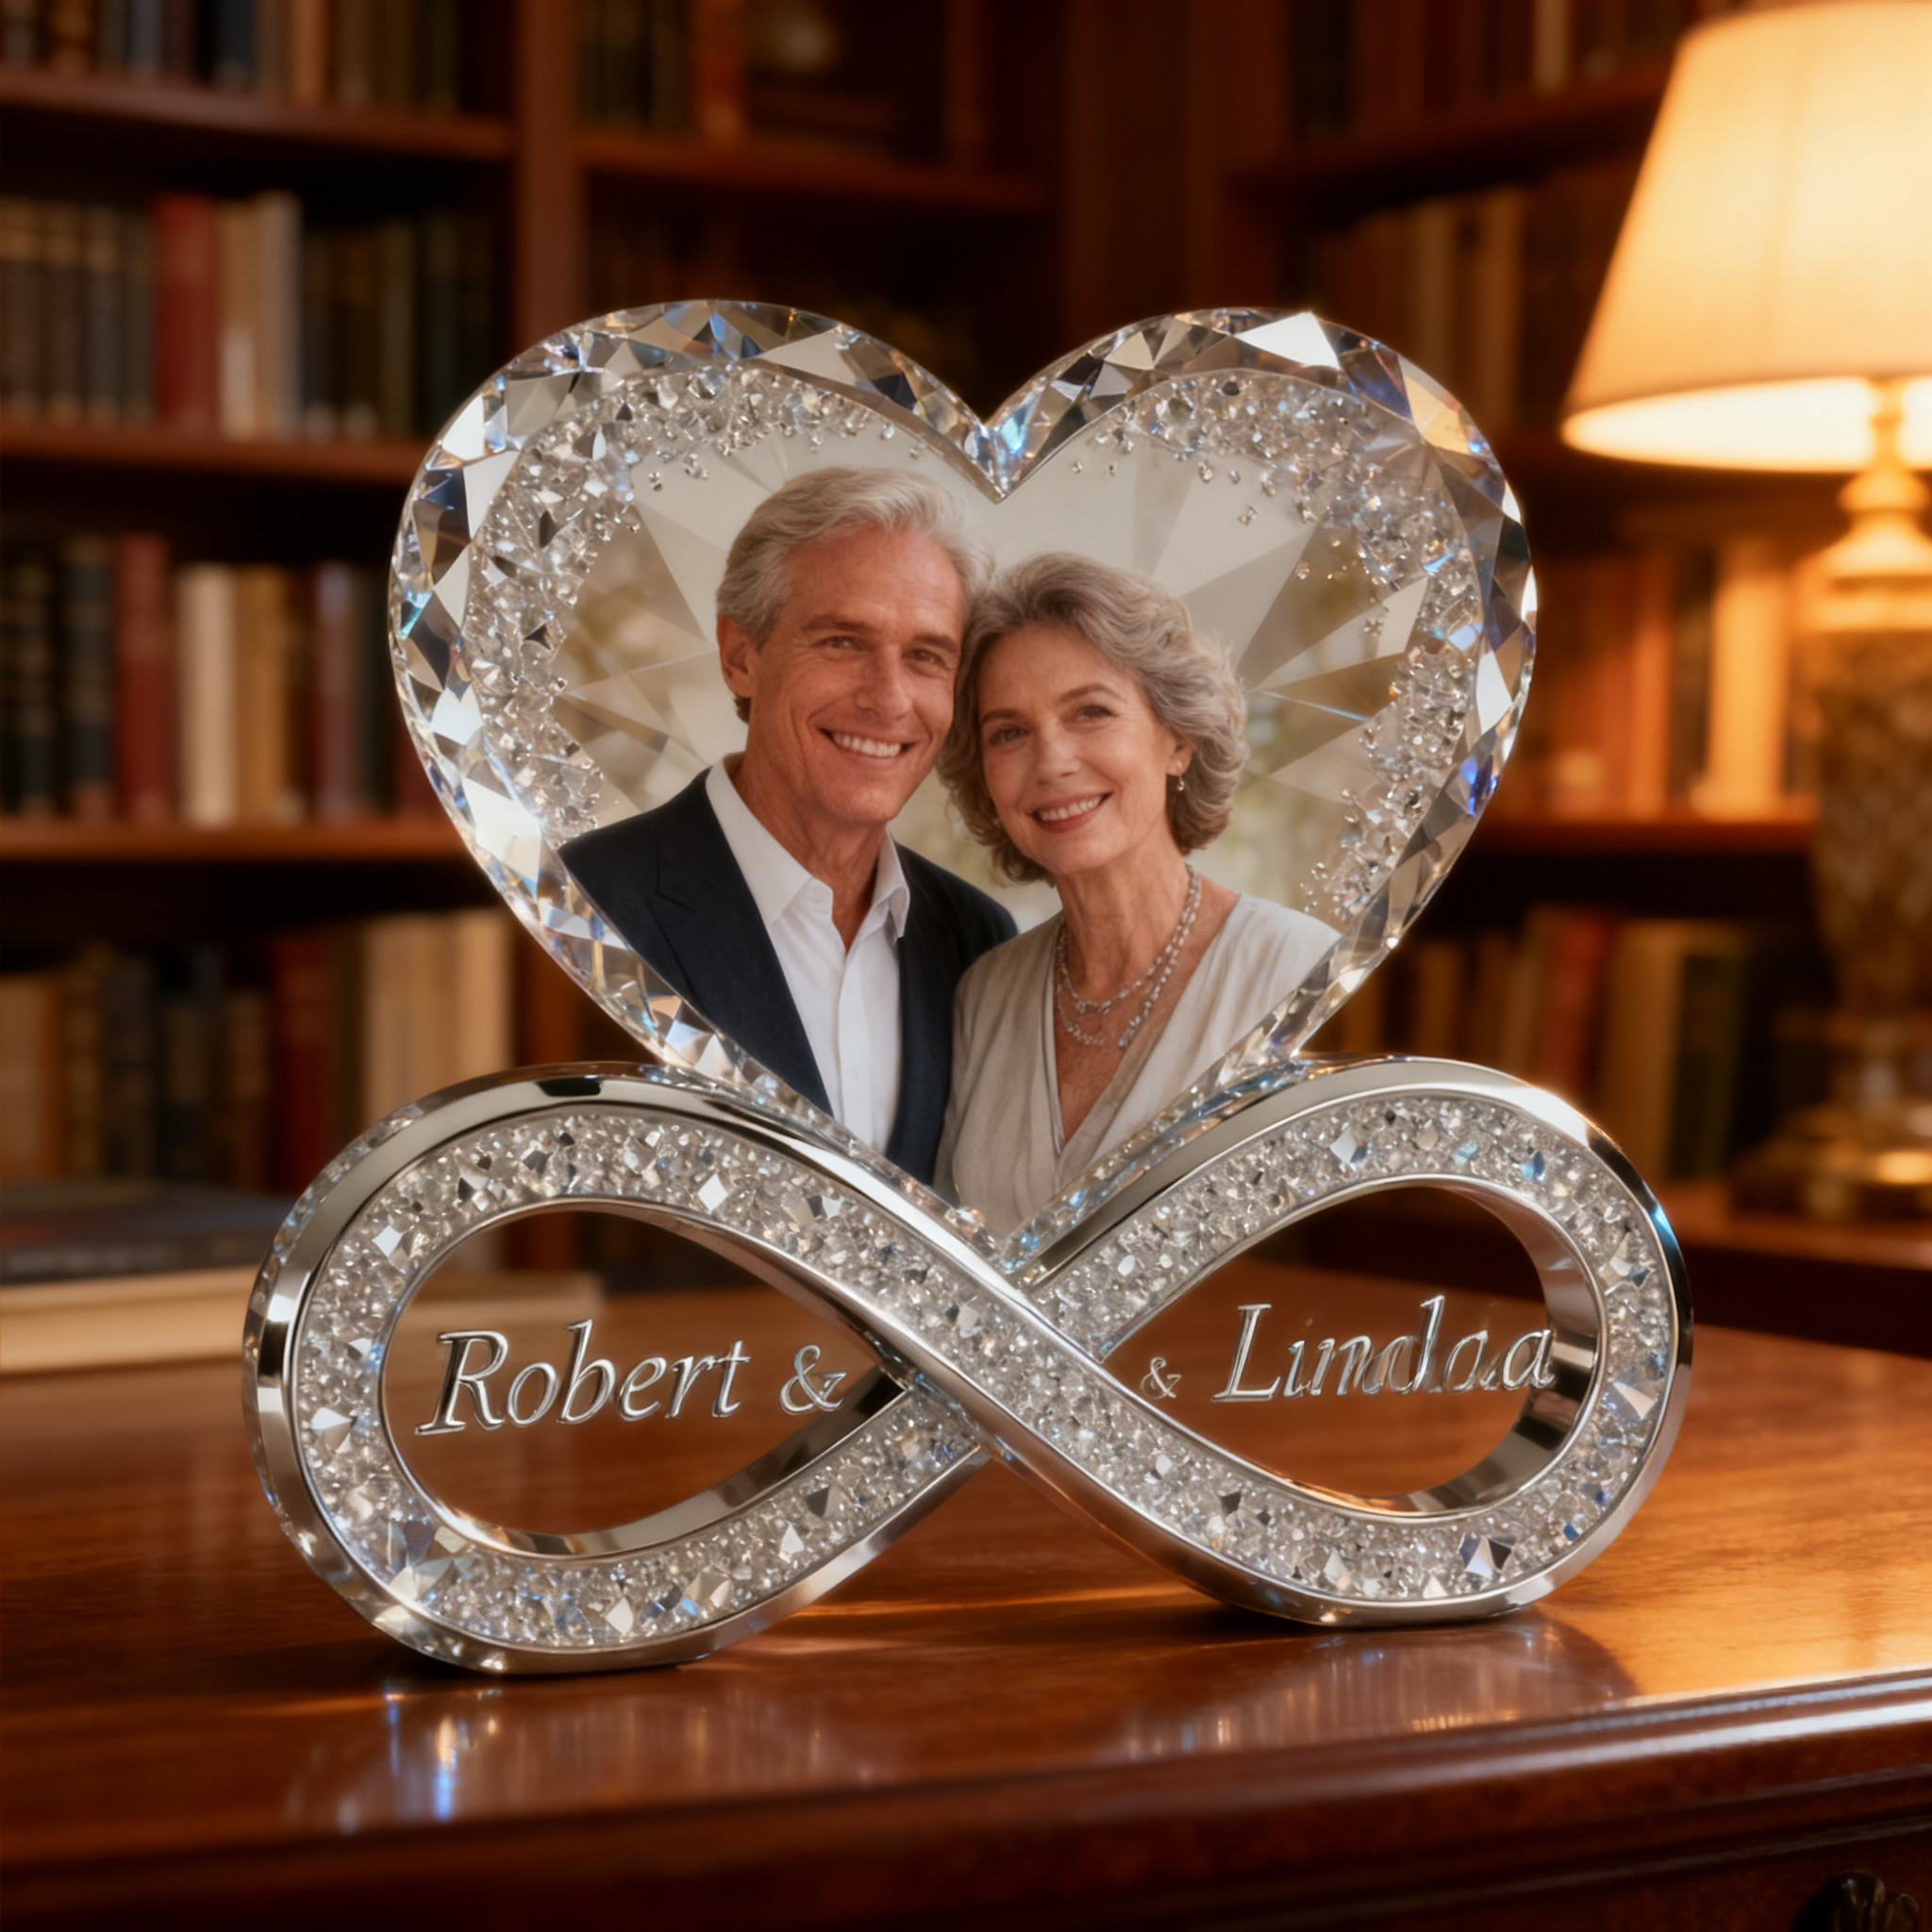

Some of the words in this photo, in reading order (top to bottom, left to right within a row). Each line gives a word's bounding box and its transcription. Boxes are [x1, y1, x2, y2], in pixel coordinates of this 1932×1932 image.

[414, 1319, 751, 1436] Robert
[778, 1344, 847, 1415] &
[1140, 1357, 1181, 1400] &
